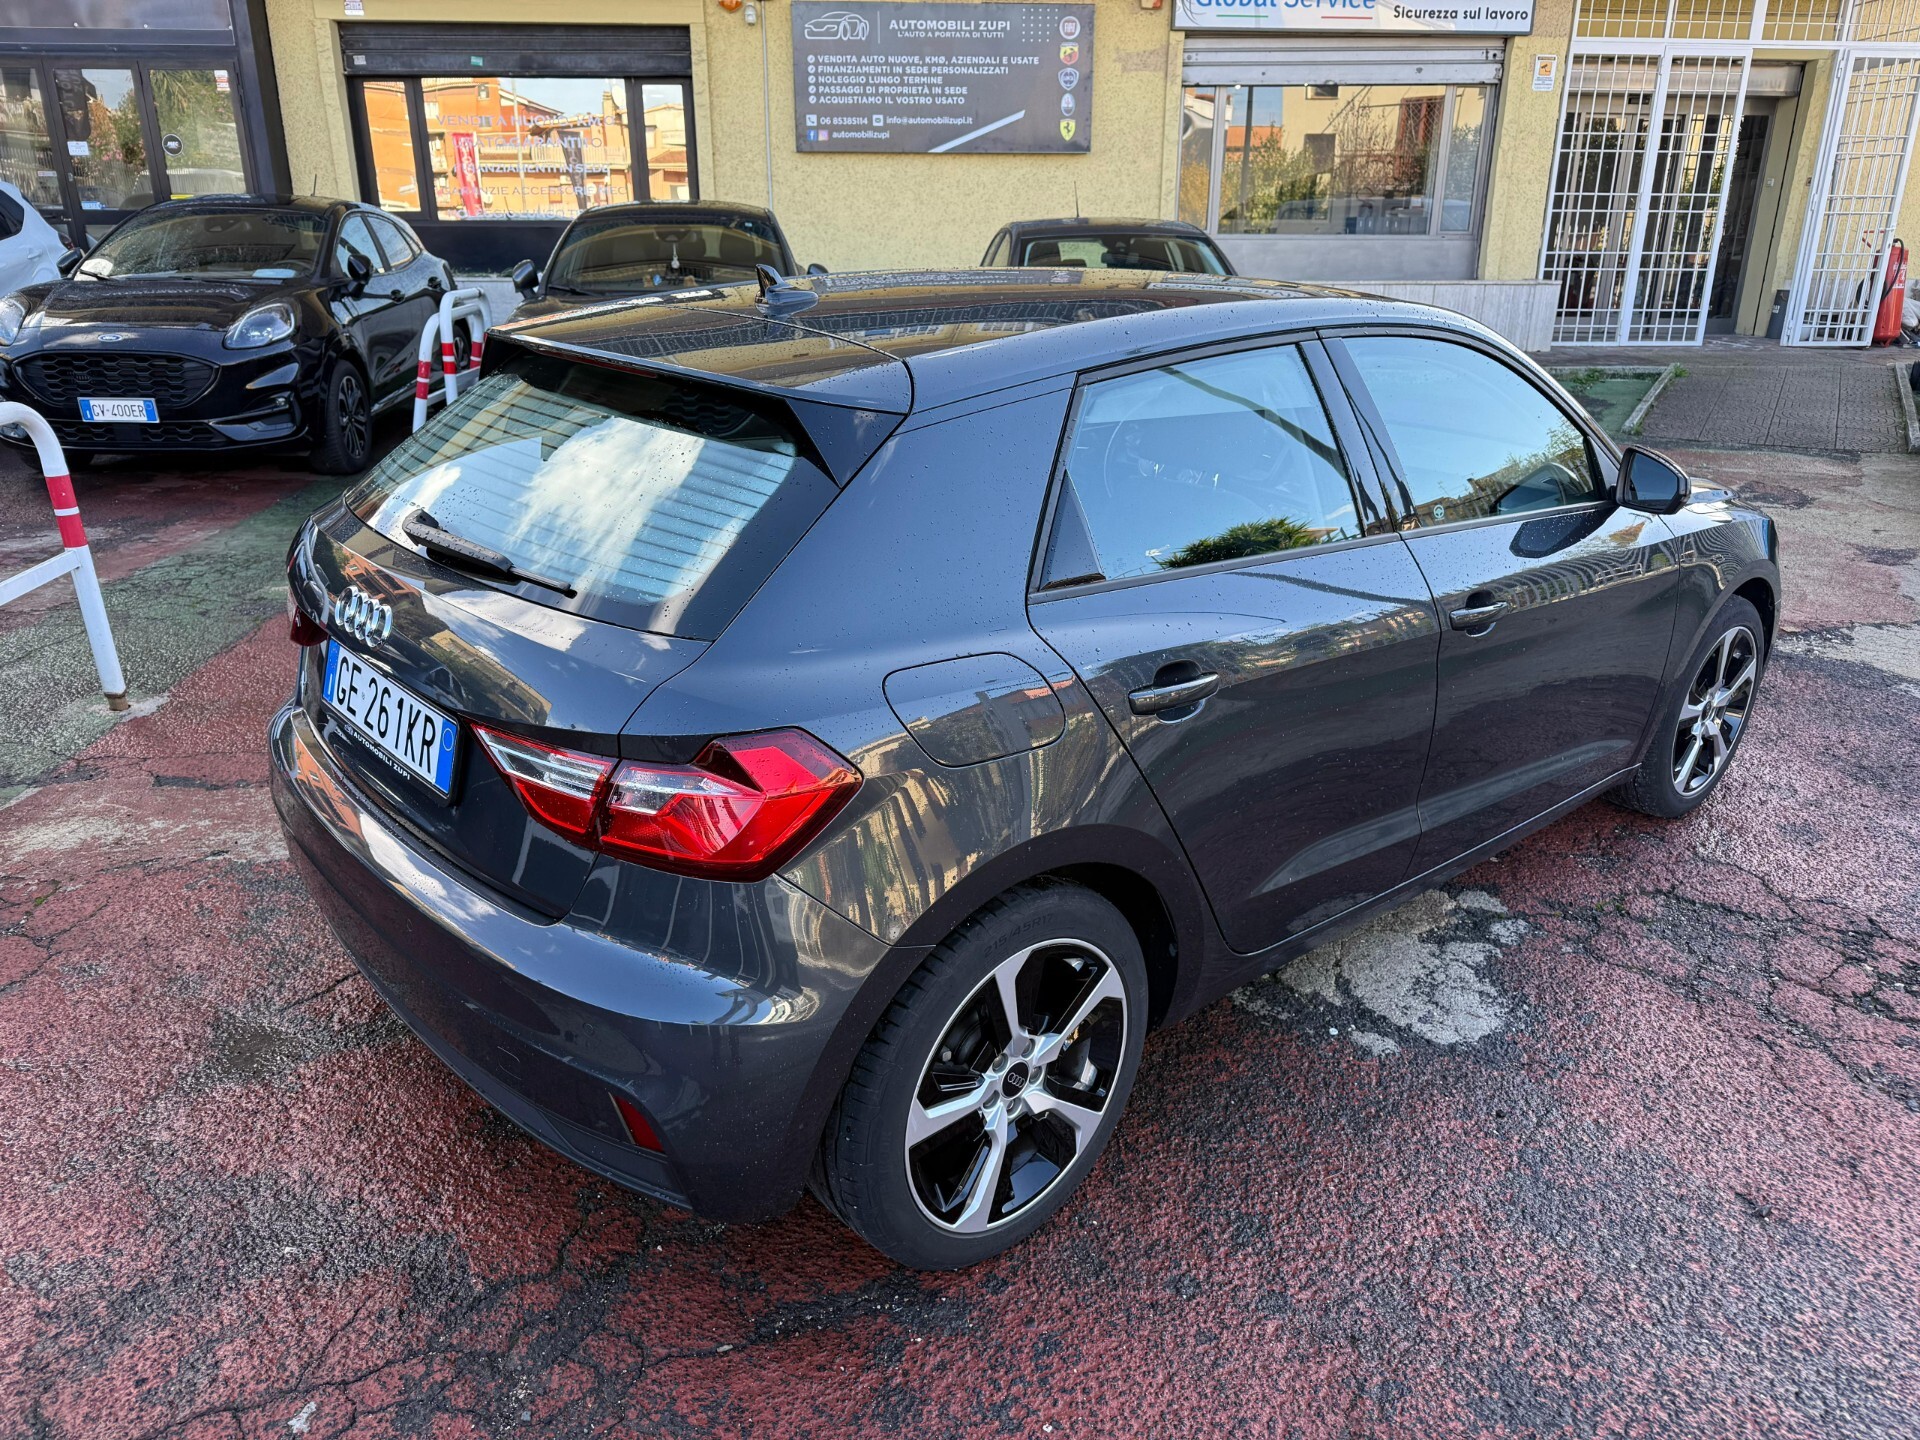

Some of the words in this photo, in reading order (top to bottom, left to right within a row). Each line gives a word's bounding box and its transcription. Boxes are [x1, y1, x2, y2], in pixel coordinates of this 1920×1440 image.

[1393, 5, 1458, 19] Sicurezza
[1463, 7, 1481, 20] sul
[1485, 7, 1529, 20] lavoro
[889, 20, 974, 30] AUTOMOBILI
[978, 20, 1011, 31] ZUPI
[817, 55, 857, 63] VENDITA
[860, 55, 885, 63] AUTO
[888, 56, 922, 65] NUOVE,
[950, 56, 999, 64] AZIENDALI
[1002, 56, 1008, 64] E
[1010, 56, 1040, 64] USATE
[817, 65, 890, 74] FINANZIAMENTI
[892, 65, 903, 74] IN
[905, 65, 928, 74] SEDE
[931, 66, 1009, 74] PERSONALIZZATI
[818, 75, 866, 84] NOLEGGIO
[868, 75, 900, 84] LUNGO
[903, 76, 943, 84] TERMINE
[818, 85, 863, 94] PASSAGGI
[865, 86, 876, 94] DI
[878, 84, 929, 94] PROPRIETÀ
[932, 86, 941, 94] IN
[944, 86, 968, 94] SEDE
[819, 96, 882, 104] ACQUISTIAMO
[884, 96, 893, 104] IL
[896, 96, 933, 105] VOSTRO
[935, 96, 965, 105] USATO
[435, 115, 507, 126] VENDITA
[820, 116, 831, 125] 06
[886, 115, 973, 125] info@automobilizupi.it
[832, 130, 890, 140] automobilizupi
[336, 656, 362, 717] GE
[363, 677, 437, 774] 261KR
[353, 731, 393, 767] AUTOMOBILI
[393, 762, 411, 781] ZUPI
